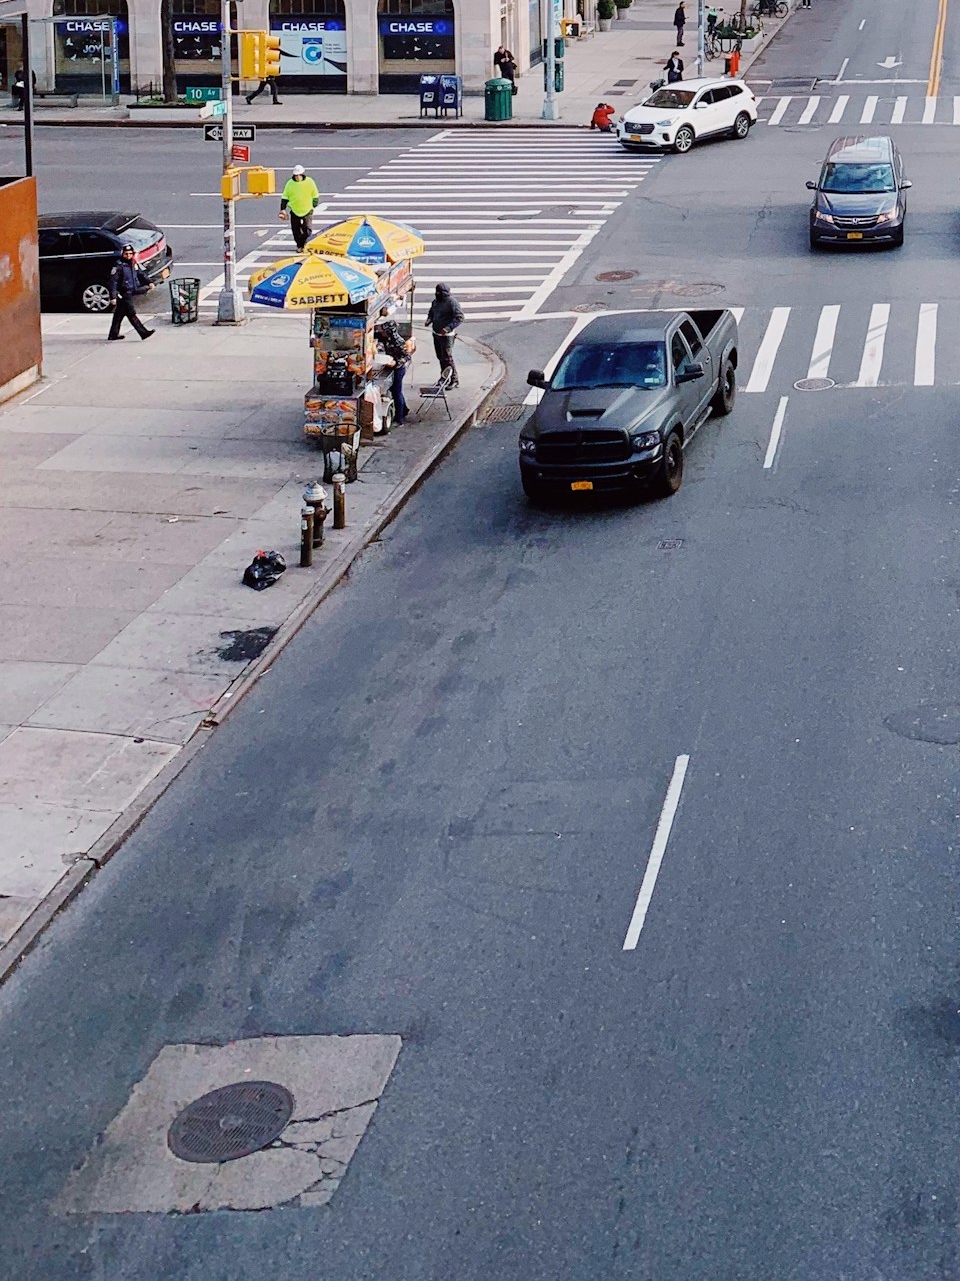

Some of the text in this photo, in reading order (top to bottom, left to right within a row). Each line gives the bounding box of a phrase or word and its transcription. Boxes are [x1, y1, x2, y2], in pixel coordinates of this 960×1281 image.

[66, 21, 110, 32] CHASE
[174, 21, 218, 32] CHASE
[282, 22, 325, 31] CHASE
[389, 22, 433, 33] CHASE
[82, 44, 102, 54] JOY
[190, 89, 202, 99] 10
[290, 292, 345, 306] SABRETT
